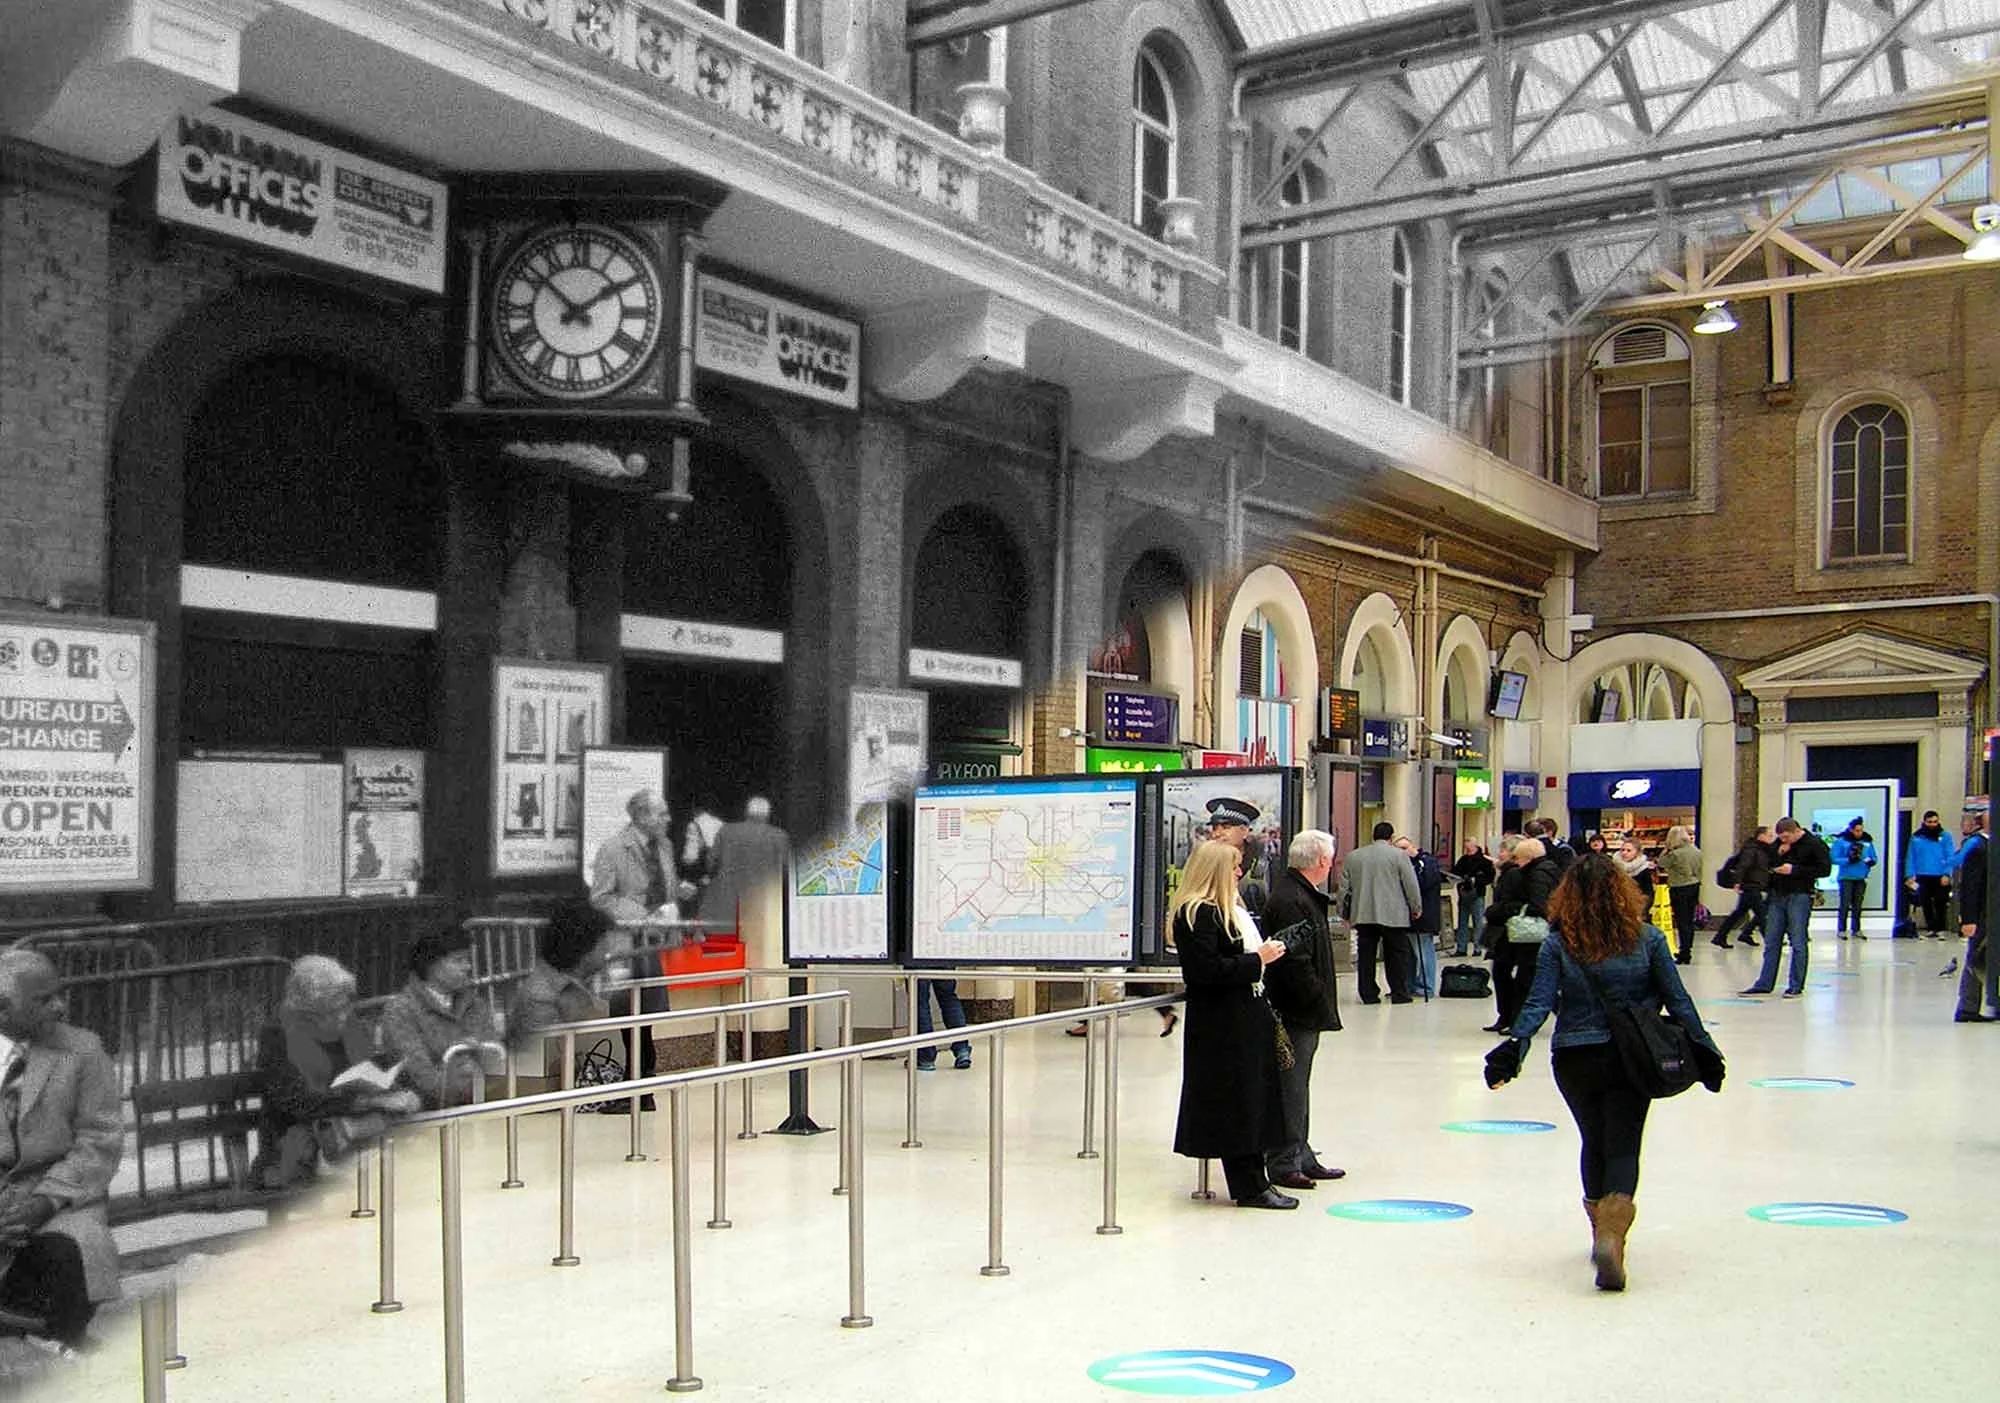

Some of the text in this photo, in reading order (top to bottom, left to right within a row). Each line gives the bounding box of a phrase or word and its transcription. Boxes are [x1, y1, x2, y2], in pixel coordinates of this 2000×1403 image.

[181, 144, 321, 217] OFFICES
[92, 703, 122, 724] DE
[0, 727, 102, 749] CHANGE
[964, 762, 997, 778] FOOD
[1, 785, 135, 799] REIGN EXCHANGE
[2, 801, 113, 831] OPEN
